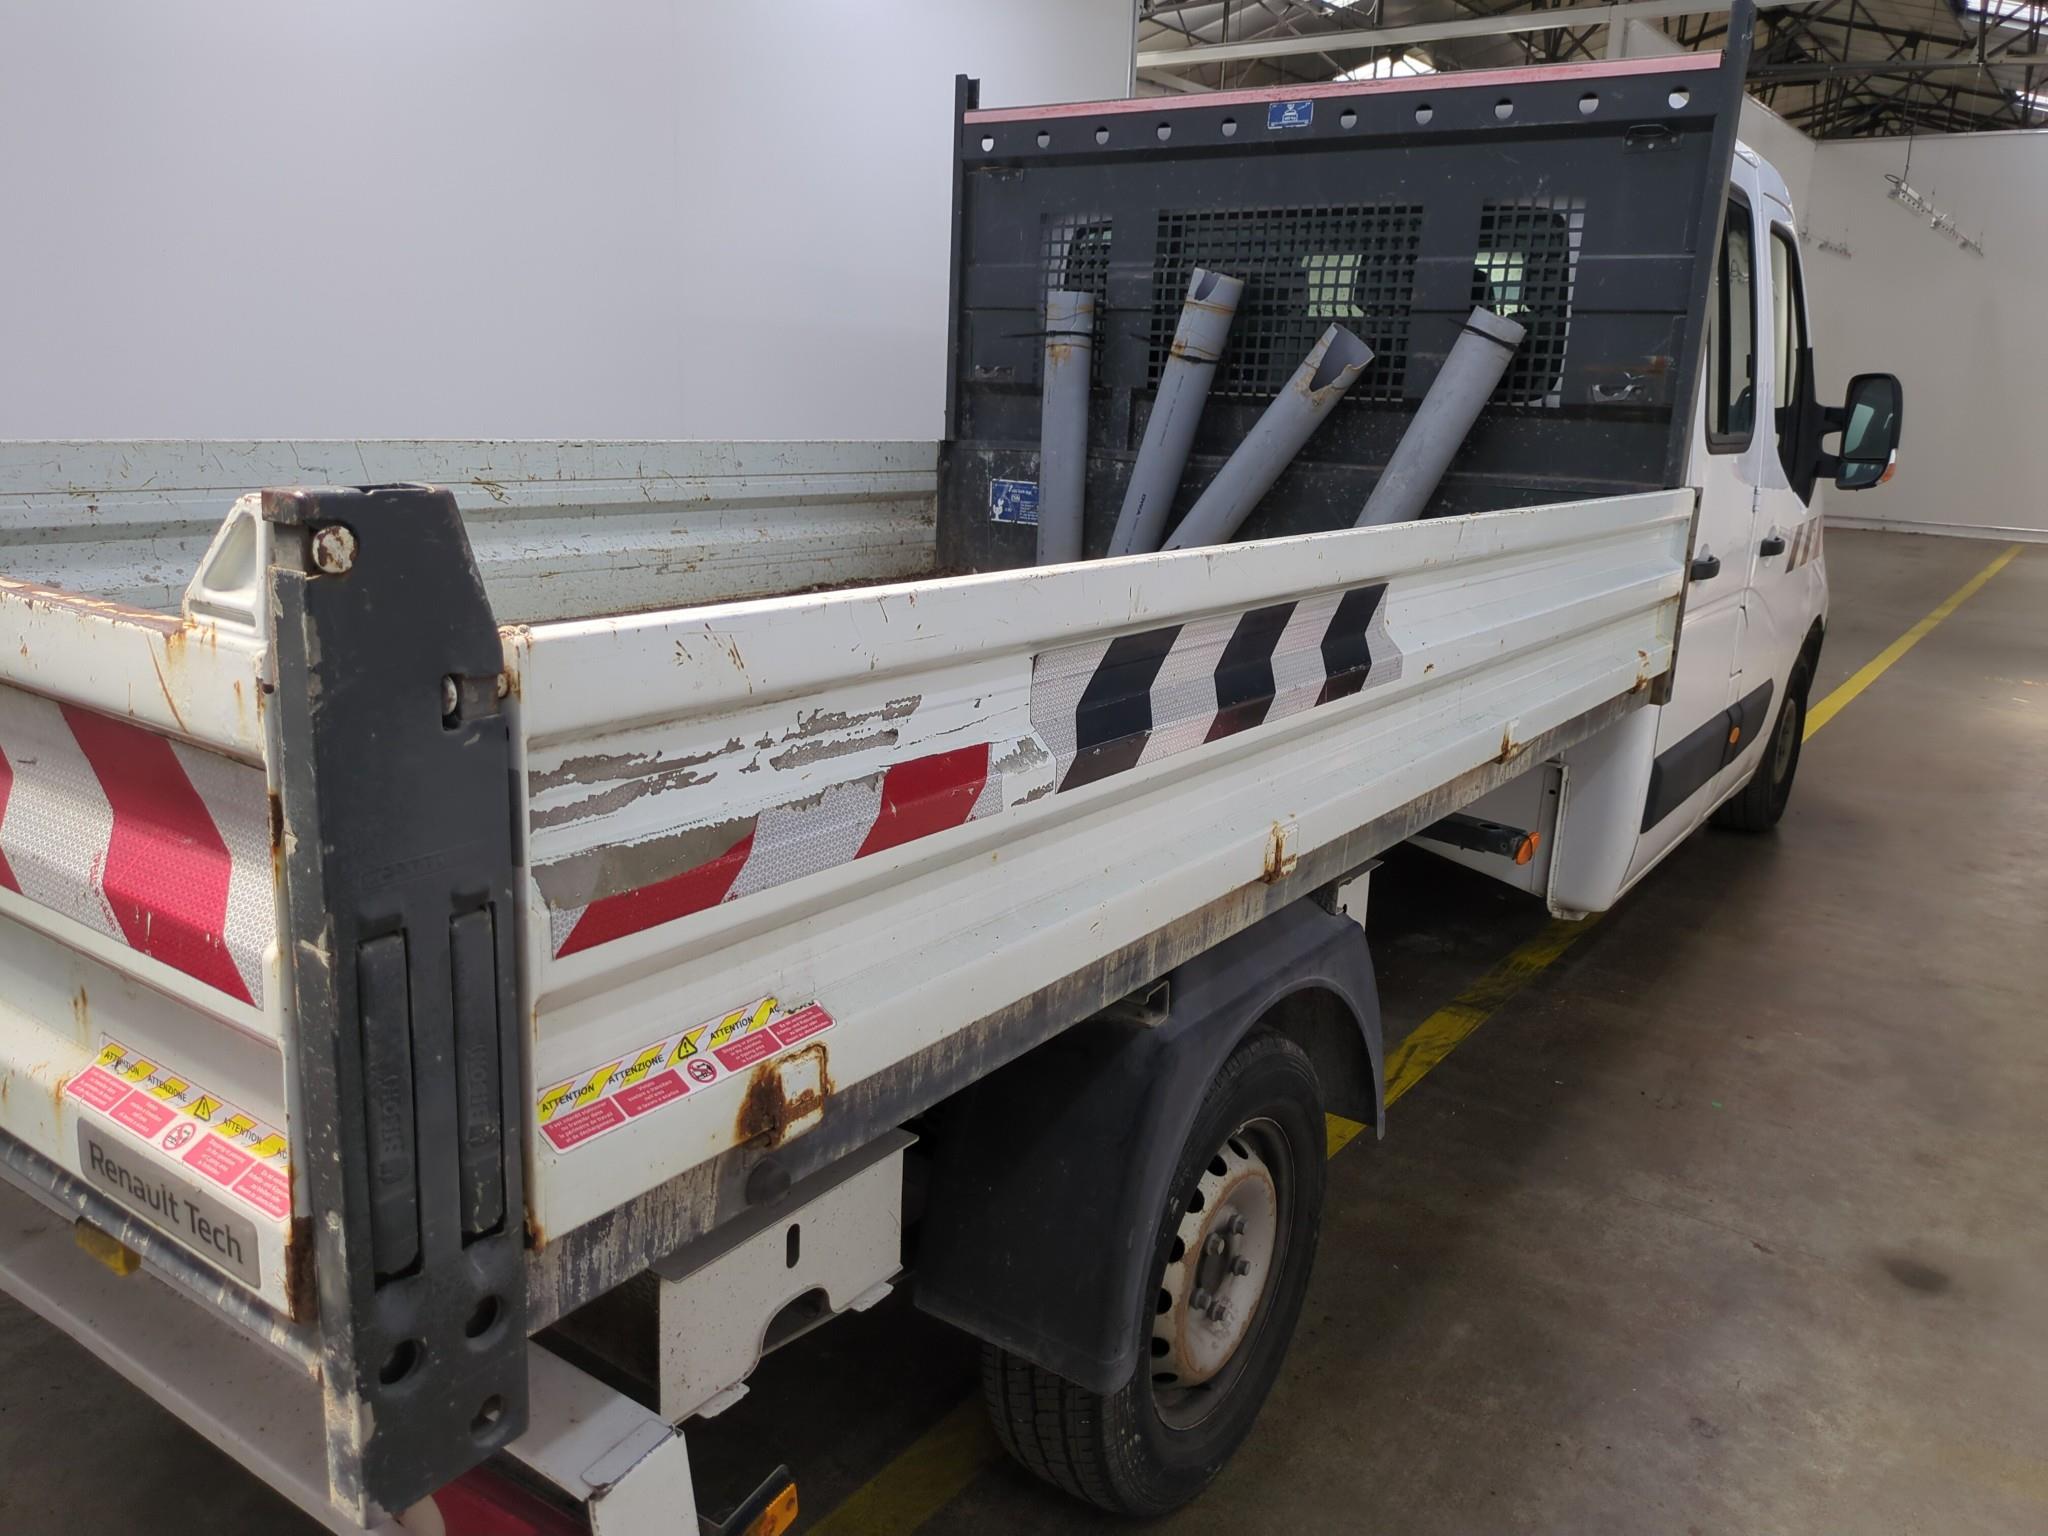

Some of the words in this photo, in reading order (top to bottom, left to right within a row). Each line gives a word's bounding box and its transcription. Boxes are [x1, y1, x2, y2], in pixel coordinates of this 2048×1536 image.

[147, 1074, 187, 1102] ATTENZIONE
[223, 1117, 262, 1144] ATTENTION
[542, 1083, 595, 1112] ATTENTION
[608, 1054, 664, 1085] ATTENZIONE
[709, 1016, 754, 1040] ATTENTION
[88, 1140, 180, 1225] Renault
[183, 1202, 244, 1264] Tech
